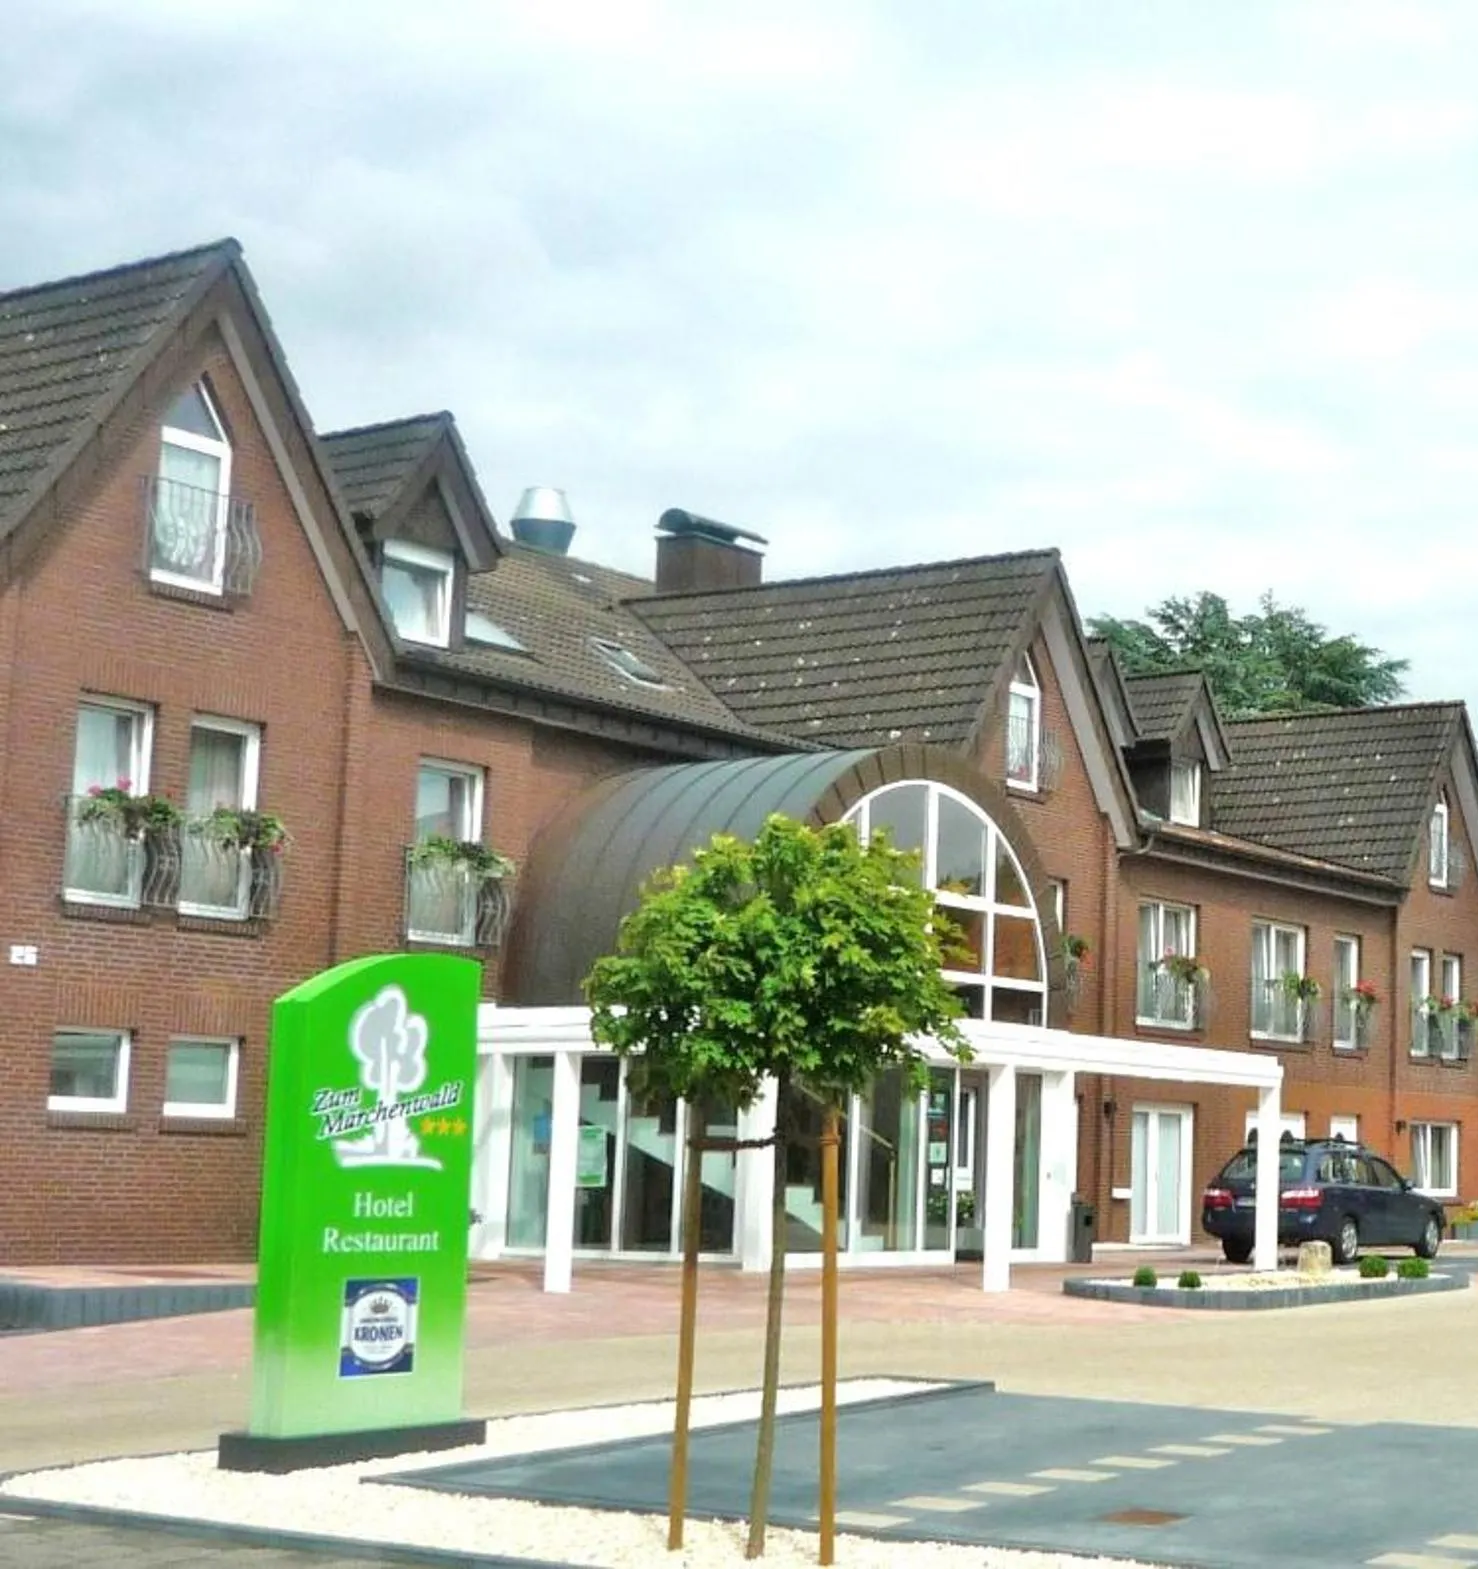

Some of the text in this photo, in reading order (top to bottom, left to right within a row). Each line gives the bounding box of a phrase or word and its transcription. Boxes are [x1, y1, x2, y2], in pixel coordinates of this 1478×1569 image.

[312, 1089, 360, 1113] Zum
[353, 1191, 413, 1217] Hotel
[323, 1227, 439, 1252] Restaurant
[354, 1327, 403, 1342] KRONEN
